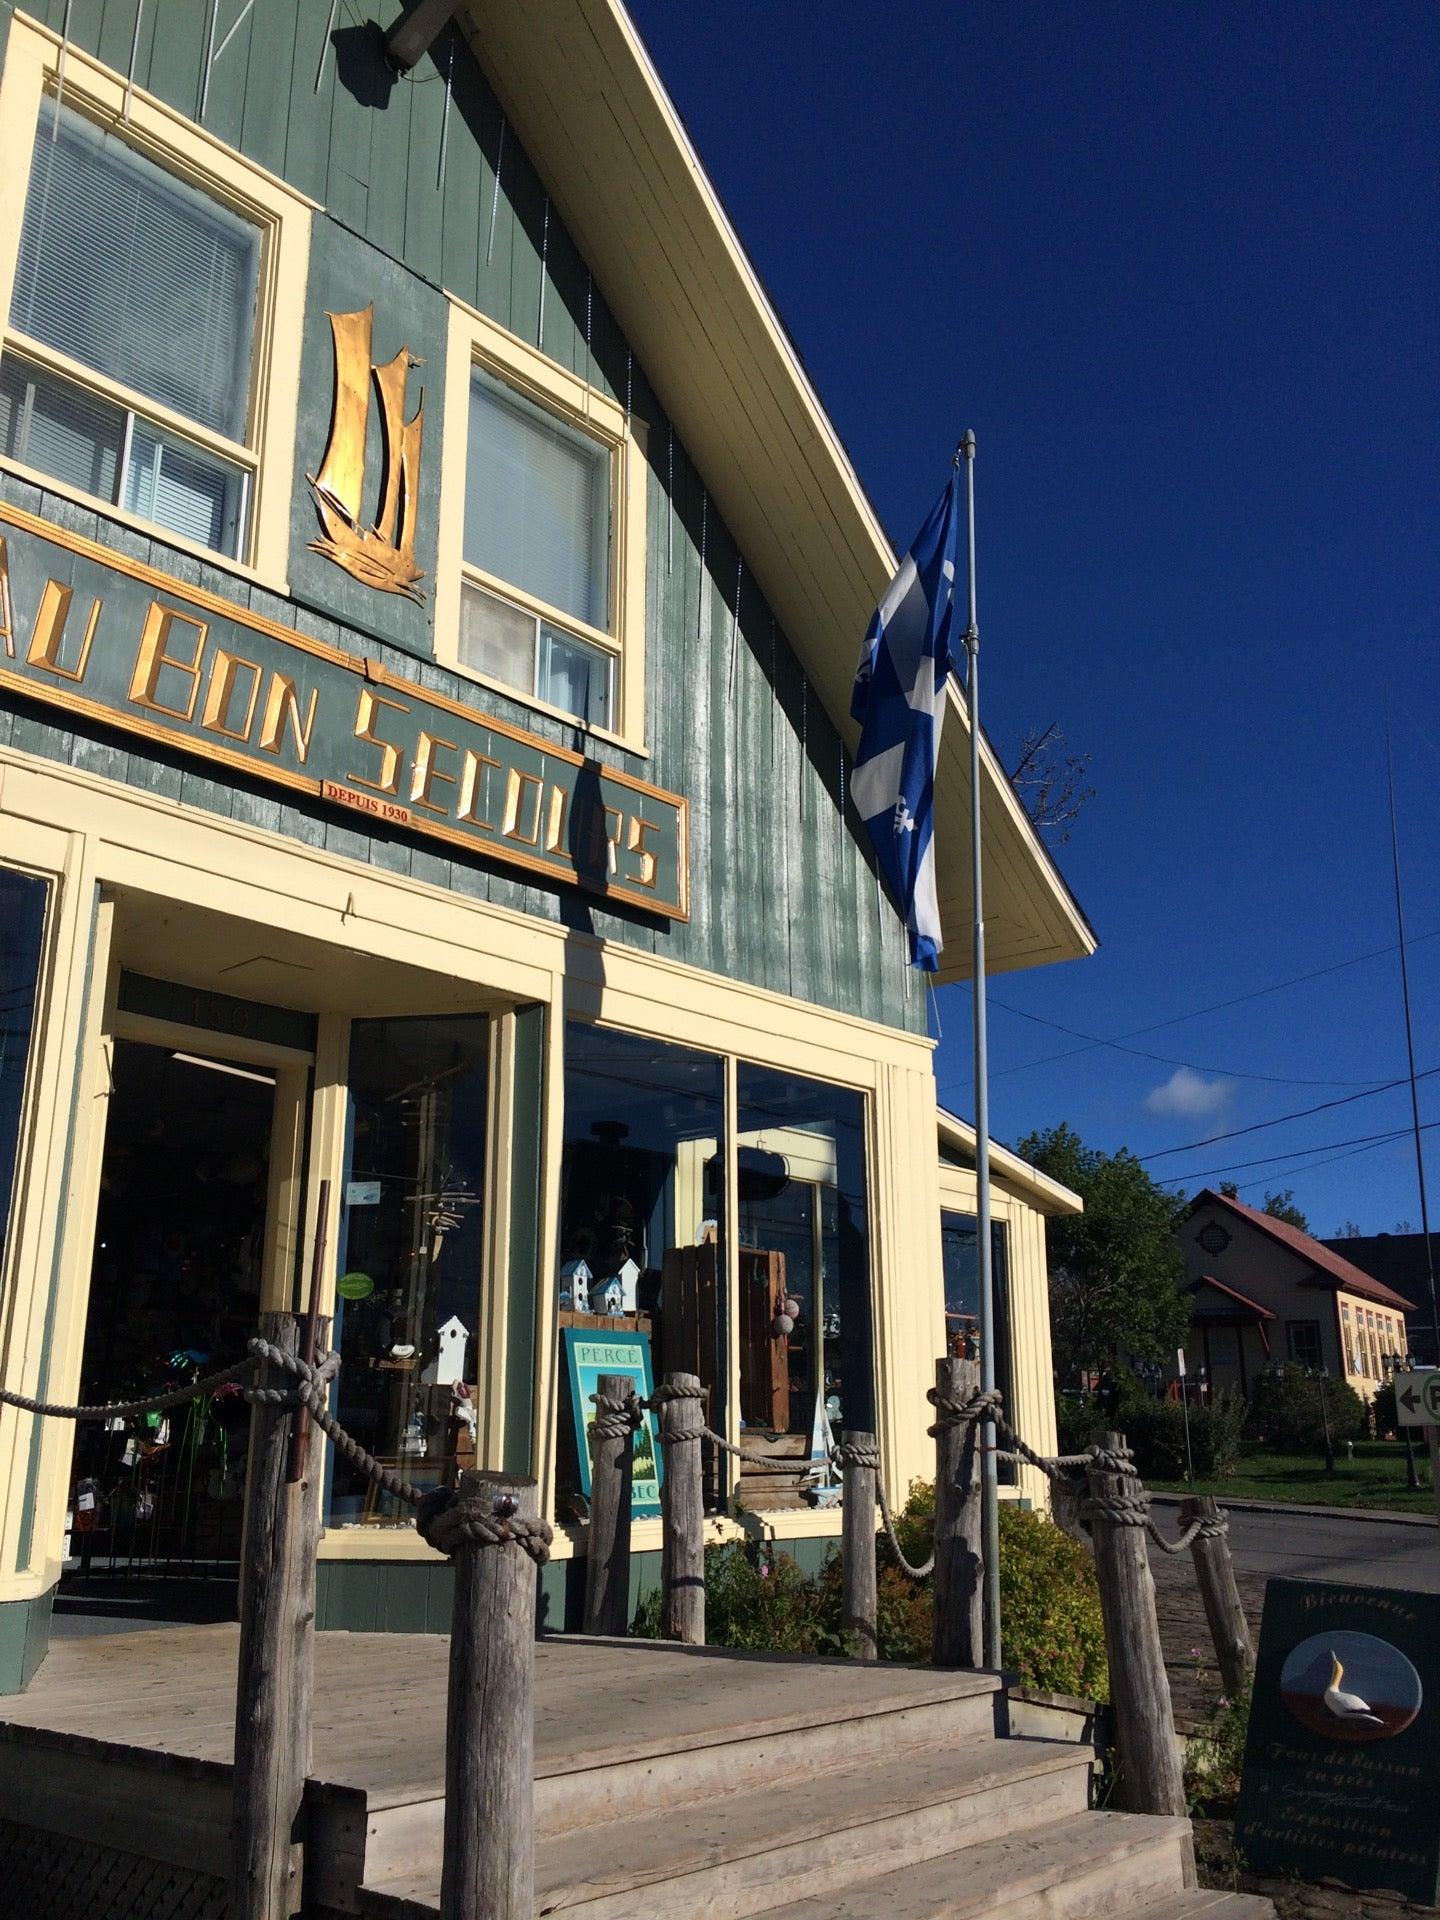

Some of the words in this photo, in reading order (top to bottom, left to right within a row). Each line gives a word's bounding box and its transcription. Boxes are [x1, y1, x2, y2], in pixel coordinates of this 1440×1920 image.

[127, 600, 320, 764] BON
[346, 688, 661, 889] SECOURS
[328, 784, 379, 812] DEPUIS
[382, 804, 408, 823] 1930
[581, 1345, 639, 1363] PERCÉ
